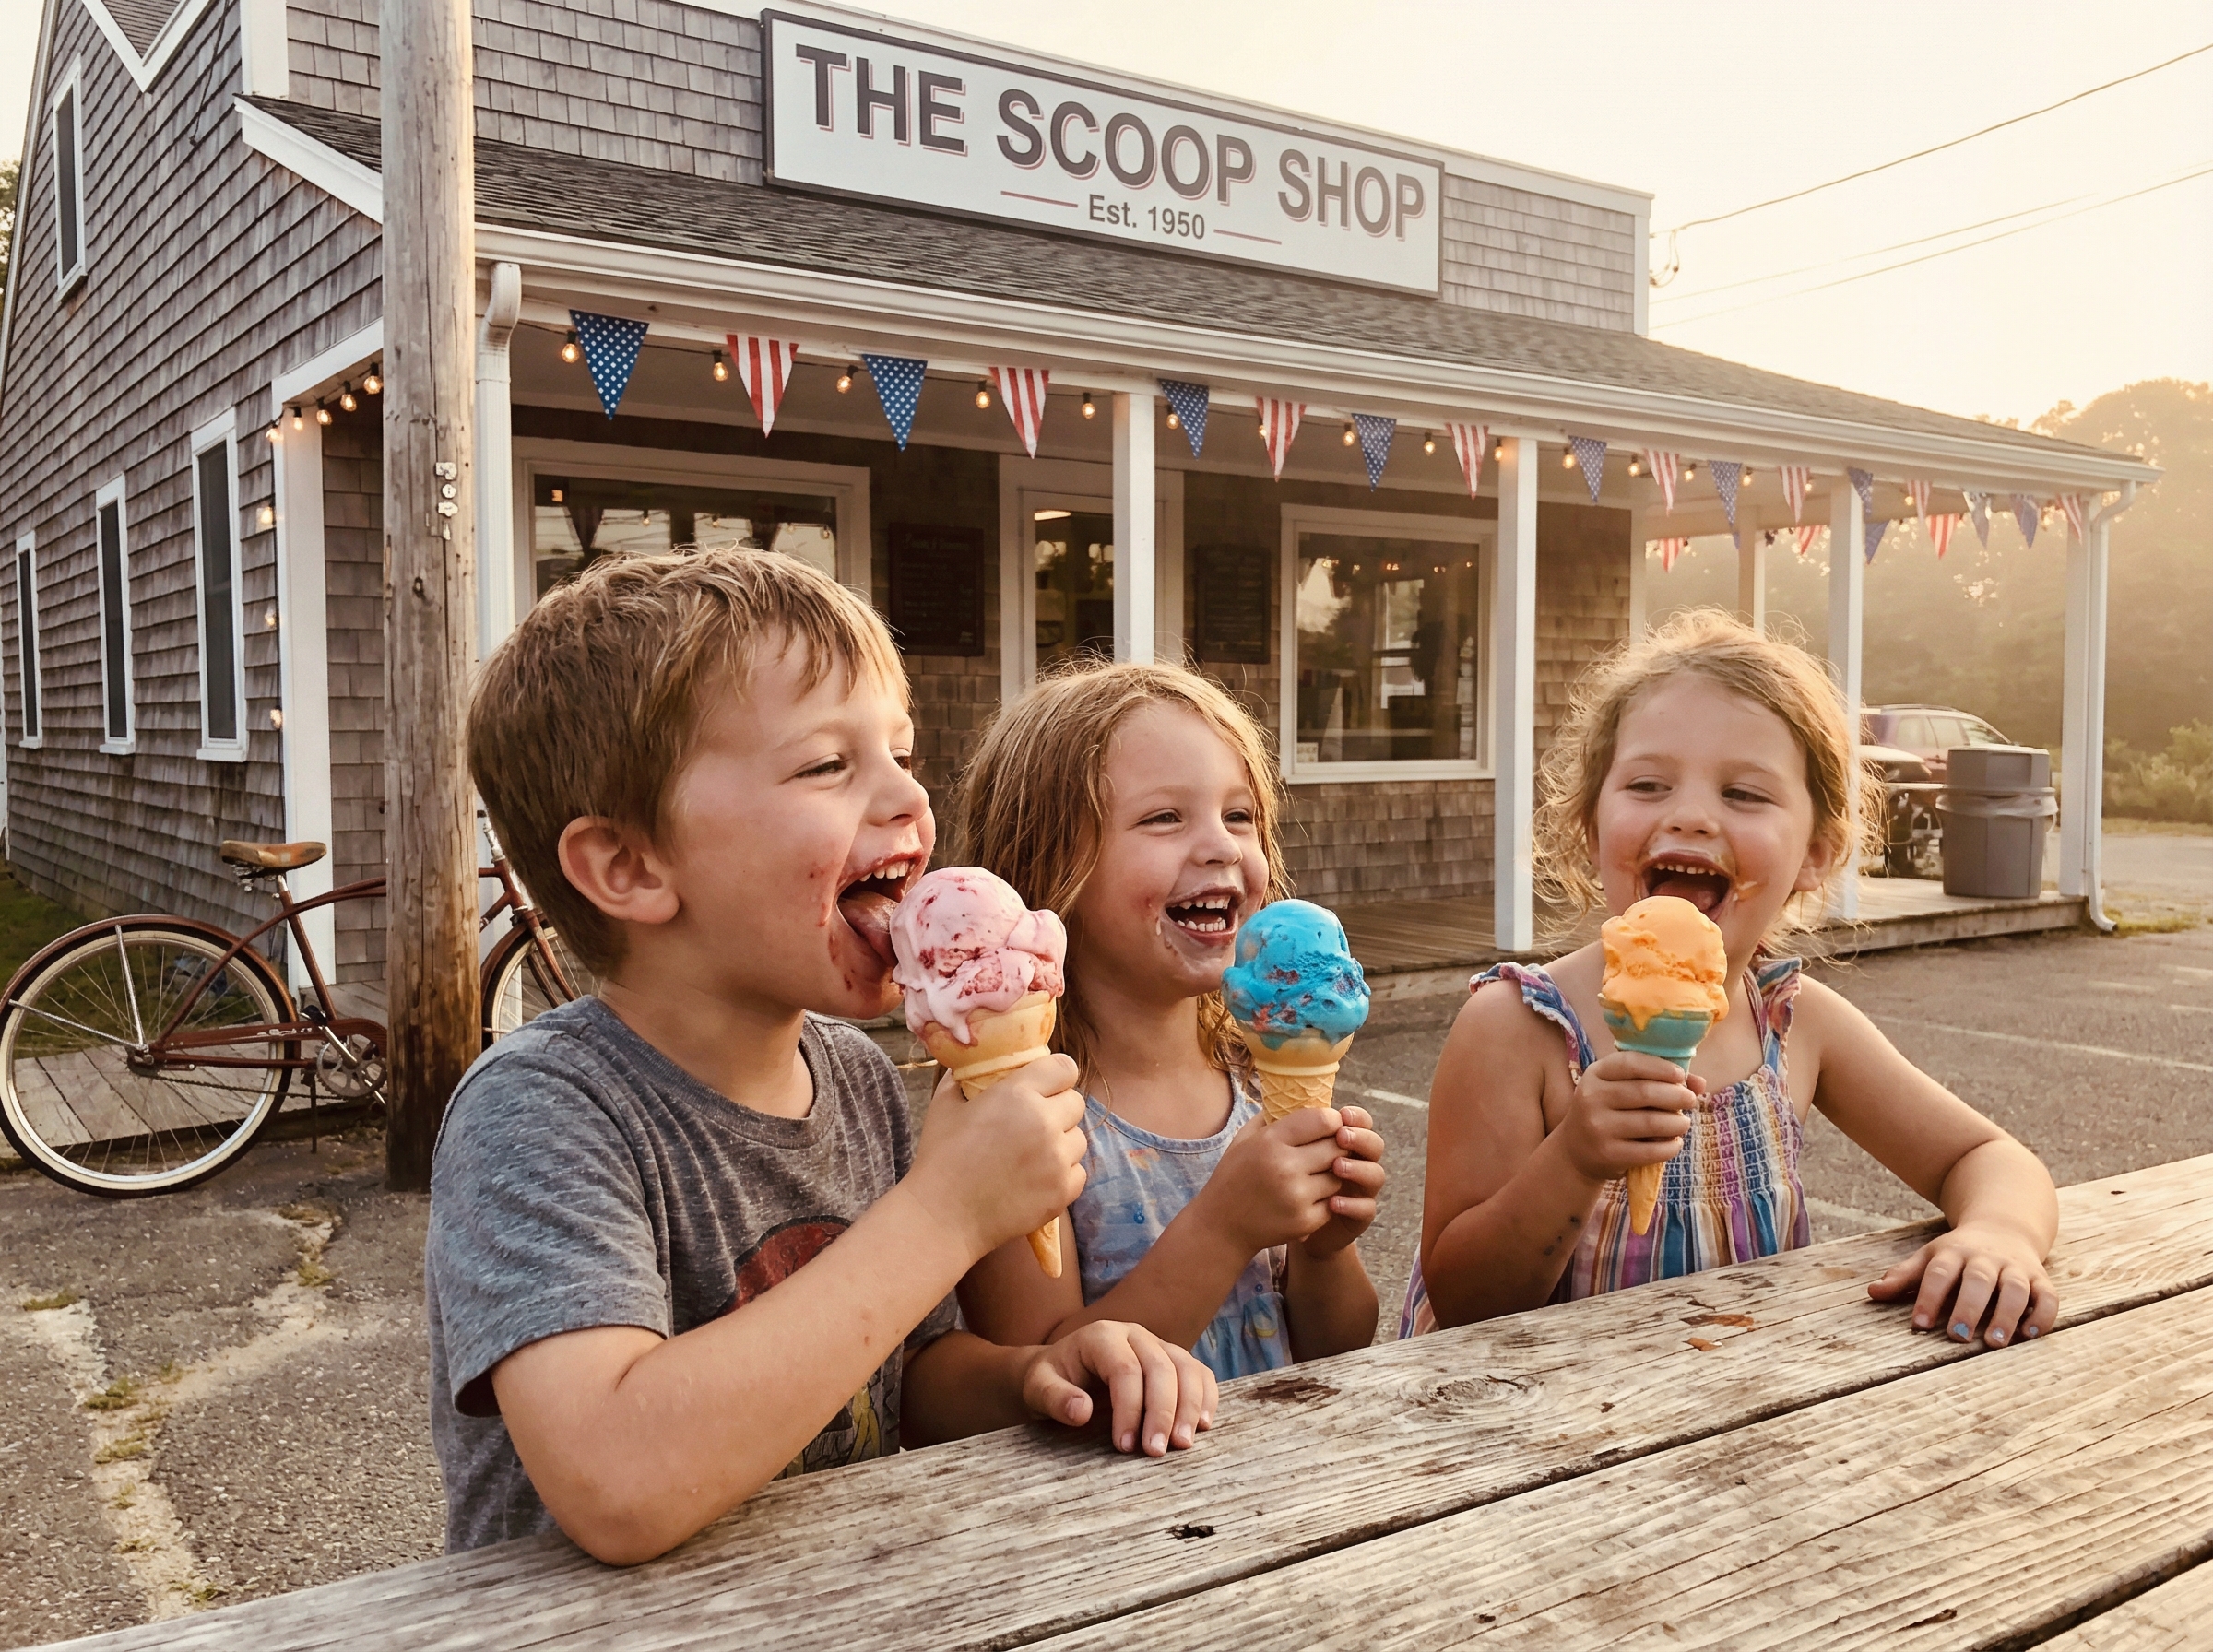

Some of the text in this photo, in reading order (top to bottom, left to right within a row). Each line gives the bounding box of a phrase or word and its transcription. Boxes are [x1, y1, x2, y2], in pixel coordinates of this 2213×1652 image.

[796, 43, 1426, 240] THE SCOOP SHOP
[1088, 194, 1206, 240] Est. 1950
